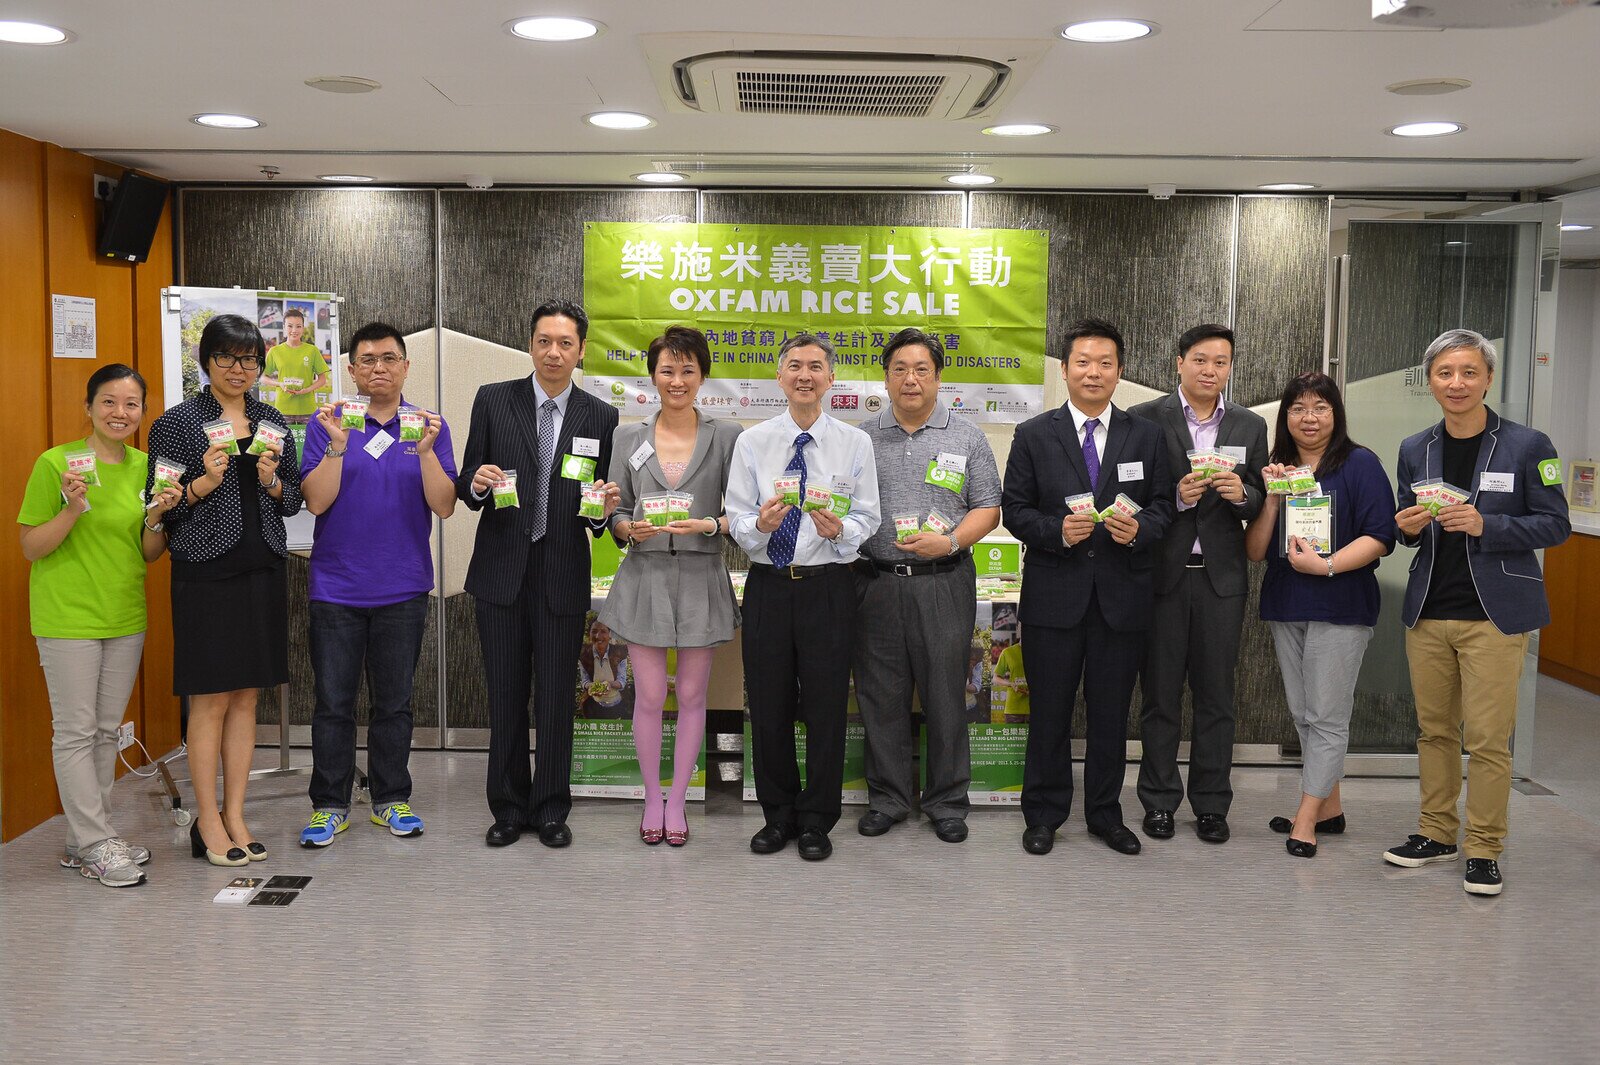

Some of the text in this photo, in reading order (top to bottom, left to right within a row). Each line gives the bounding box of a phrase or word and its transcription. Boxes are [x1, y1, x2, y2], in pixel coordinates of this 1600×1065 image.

[620, 240, 1012, 287] 樂施米義賣大行動
[669, 288, 960, 316] OXFAM RICE SALE
[607, 350, 636, 361] HELP
[723, 352, 735, 363] IN
[739, 352, 775, 363] CHINA
[833, 353, 868, 365] AINST
[956, 356, 1021, 368] DISASTERS
[209, 427, 232, 439] 樂施米
[986, 727, 1029, 736] 由一包樂施
